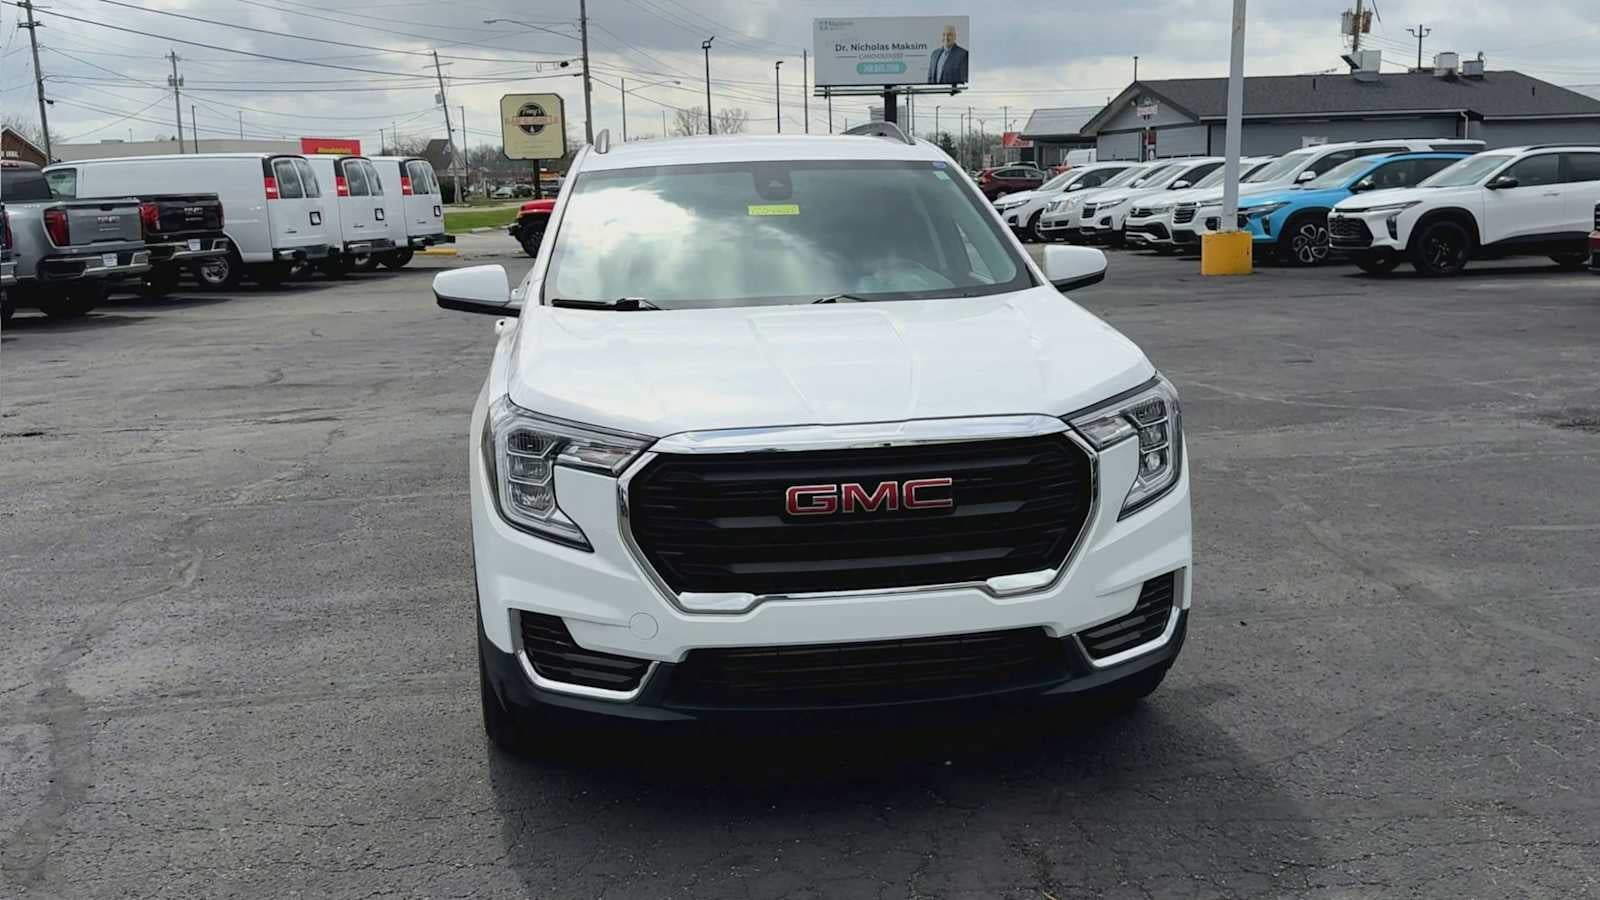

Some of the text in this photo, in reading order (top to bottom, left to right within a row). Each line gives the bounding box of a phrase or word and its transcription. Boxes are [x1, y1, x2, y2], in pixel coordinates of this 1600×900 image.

[835, 41, 927, 52] Dr. Nicholas Maksim
[785, 477, 953, 516] GMC
